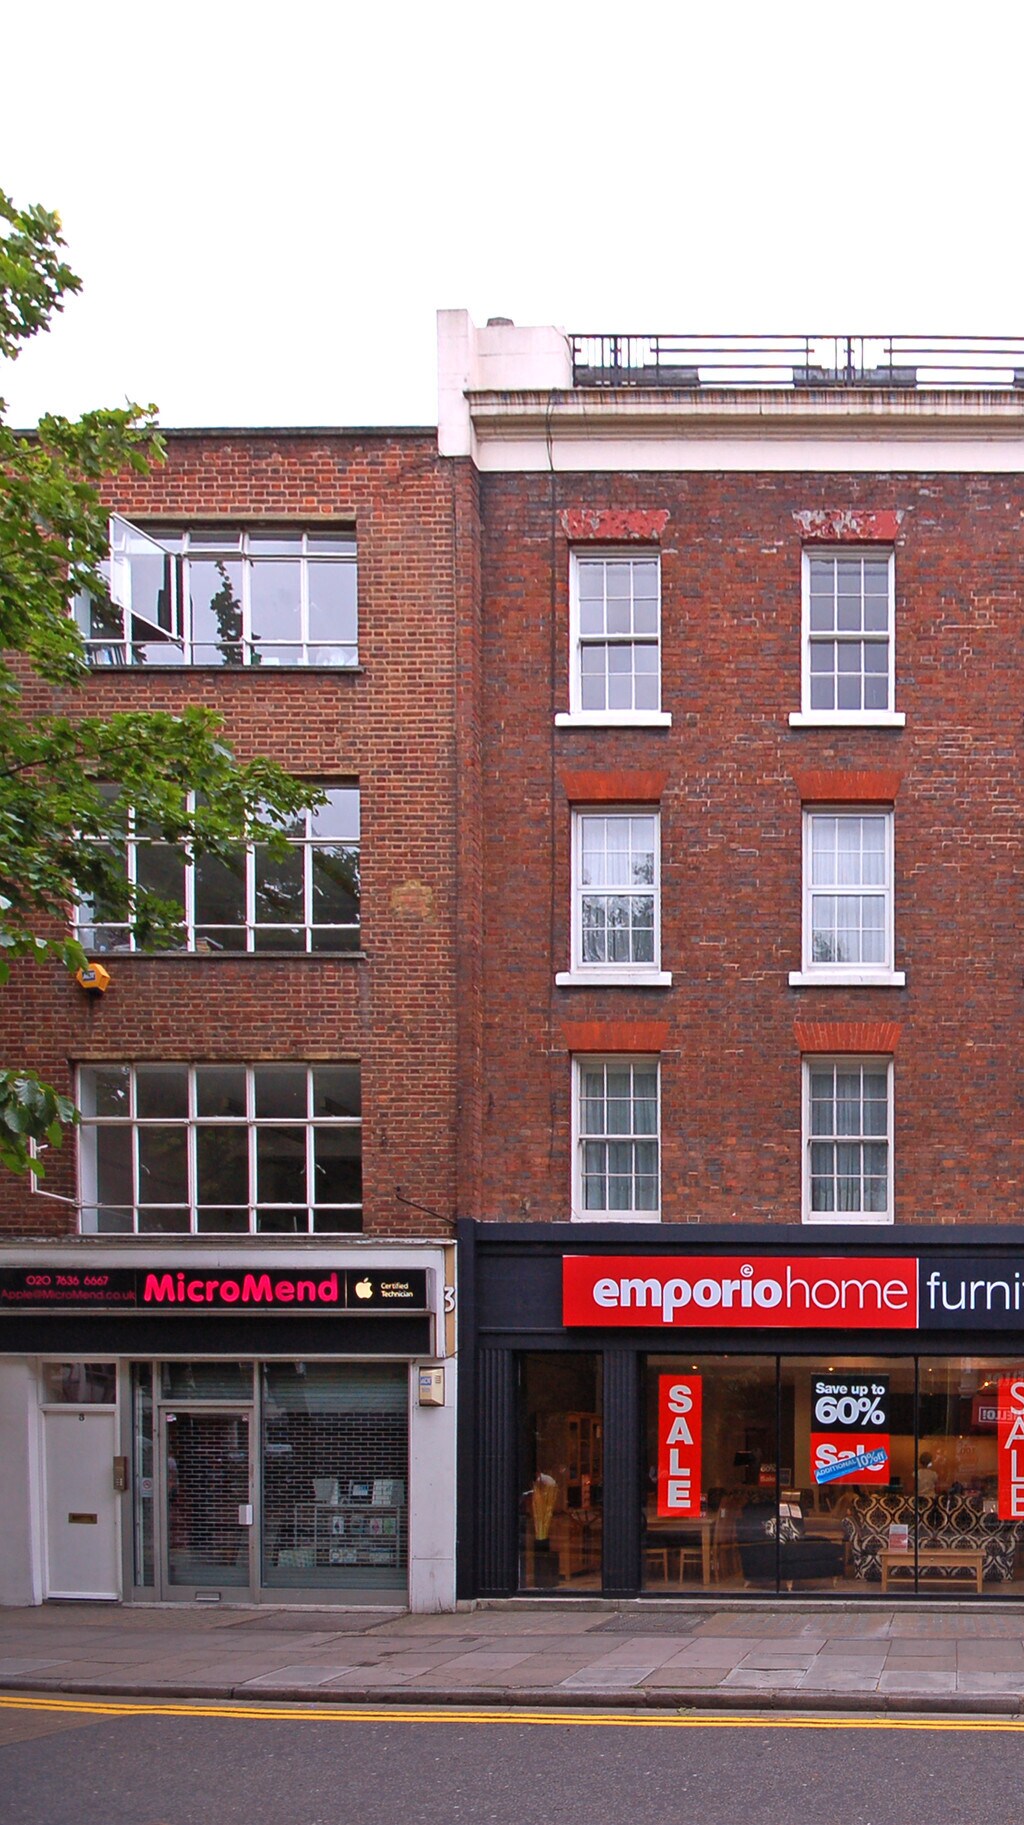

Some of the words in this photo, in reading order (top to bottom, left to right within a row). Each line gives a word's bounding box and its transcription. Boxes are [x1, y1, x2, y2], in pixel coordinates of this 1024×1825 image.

[25, 1275, 52, 1286] 020
[56, 1275, 80, 1286] 7636
[83, 1275, 109, 1286] 6667
[144, 1272, 338, 1302] MicroMend
[380, 1282, 409, 1290] Certified
[381, 1290, 413, 1298] Technician
[444, 1286, 455, 1312] 3
[815, 1382, 848, 1395] Save
[850, 1385, 869, 1397] up
[871, 1384, 886, 1396] to
[814, 1396, 886, 1426] 60%
[667, 1385, 694, 1507] SALE
[815, 1458, 857, 1476] ADDITIONAL
